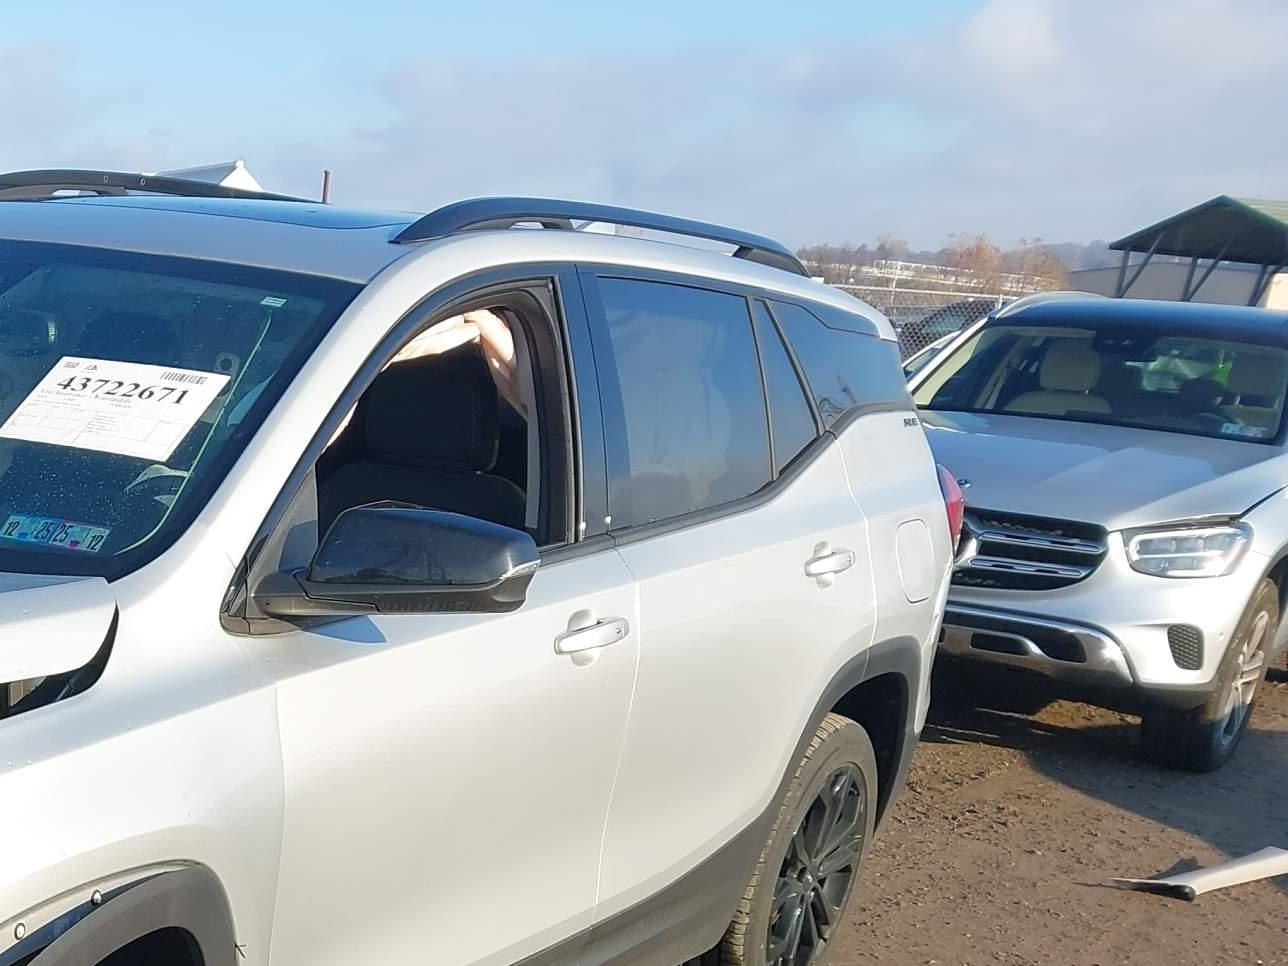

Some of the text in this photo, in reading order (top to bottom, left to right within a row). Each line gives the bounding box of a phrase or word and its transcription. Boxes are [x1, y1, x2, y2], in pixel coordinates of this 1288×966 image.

[57, 375, 189, 405] 43722671
[3, 519, 55, 540] 12 25
[52, 523, 104, 551] 25 12
